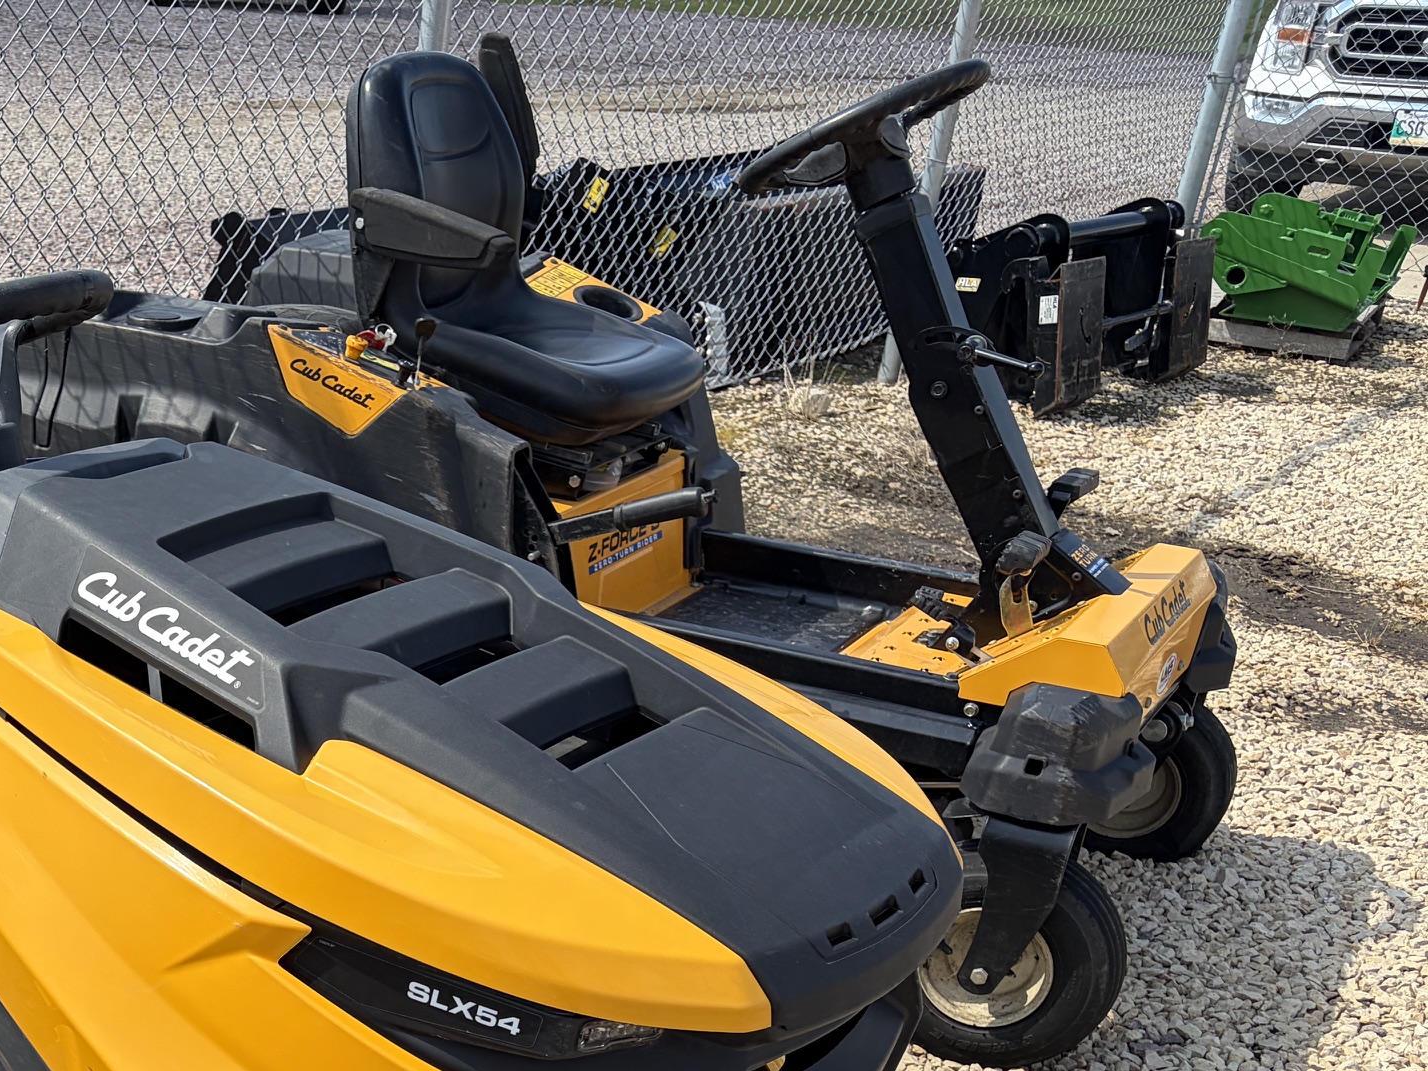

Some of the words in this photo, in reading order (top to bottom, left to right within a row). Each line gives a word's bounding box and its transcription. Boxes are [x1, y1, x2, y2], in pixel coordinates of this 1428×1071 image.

[290, 358, 322, 382] Cub
[321, 374, 376, 409] Cadet
[636, 532, 659, 550] RIDER
[1070, 543, 1091, 562] ZERO
[1078, 549, 1099, 568] TURN
[77, 571, 147, 622] Cub
[138, 606, 255, 684] Cadet
[1144, 607, 1166, 646] Cub
[407, 981, 521, 1036] SLX54
